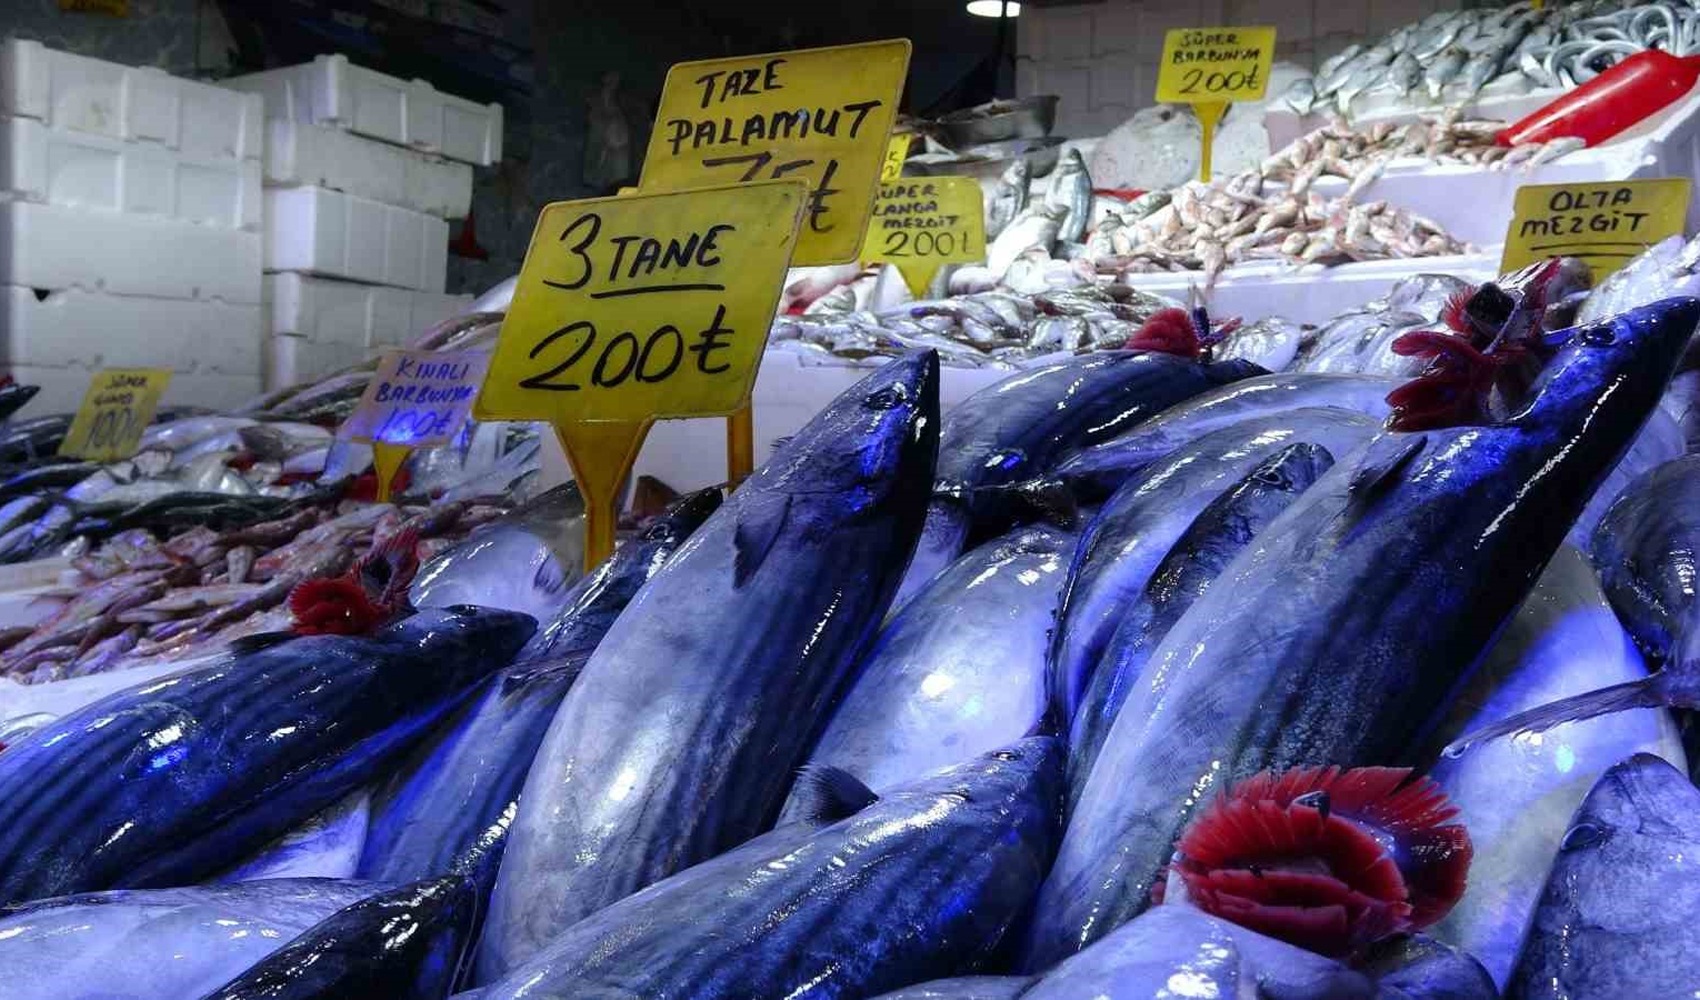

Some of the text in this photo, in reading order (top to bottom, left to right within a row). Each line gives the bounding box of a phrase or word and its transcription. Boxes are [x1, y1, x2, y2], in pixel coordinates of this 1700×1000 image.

[696, 59, 788, 108] TAZE
[667, 100, 882, 155] PALAMUT
[1550, 188, 1632, 212] OLTA
[543, 213, 735, 289] 3 TANE
